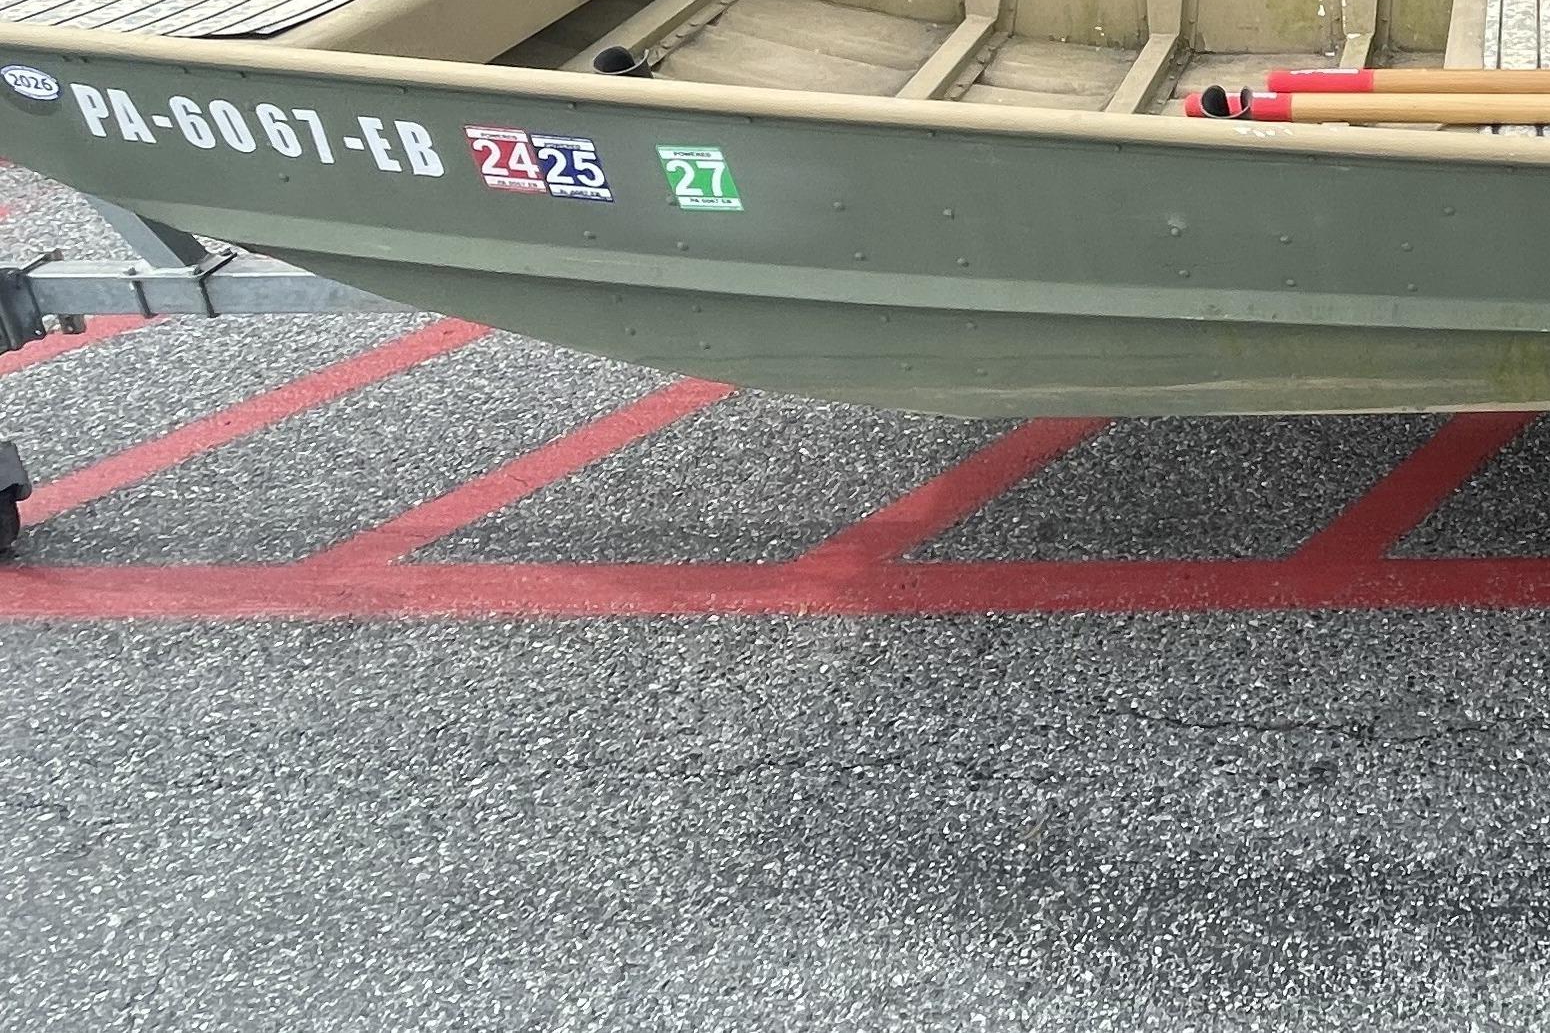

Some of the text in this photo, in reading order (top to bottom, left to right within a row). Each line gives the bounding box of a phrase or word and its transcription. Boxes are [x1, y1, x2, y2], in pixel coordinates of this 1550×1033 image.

[8, 73, 53, 93] 2026
[472, 138, 541, 179] 24
[538, 147, 606, 188] 25
[666, 159, 726, 197] 27
